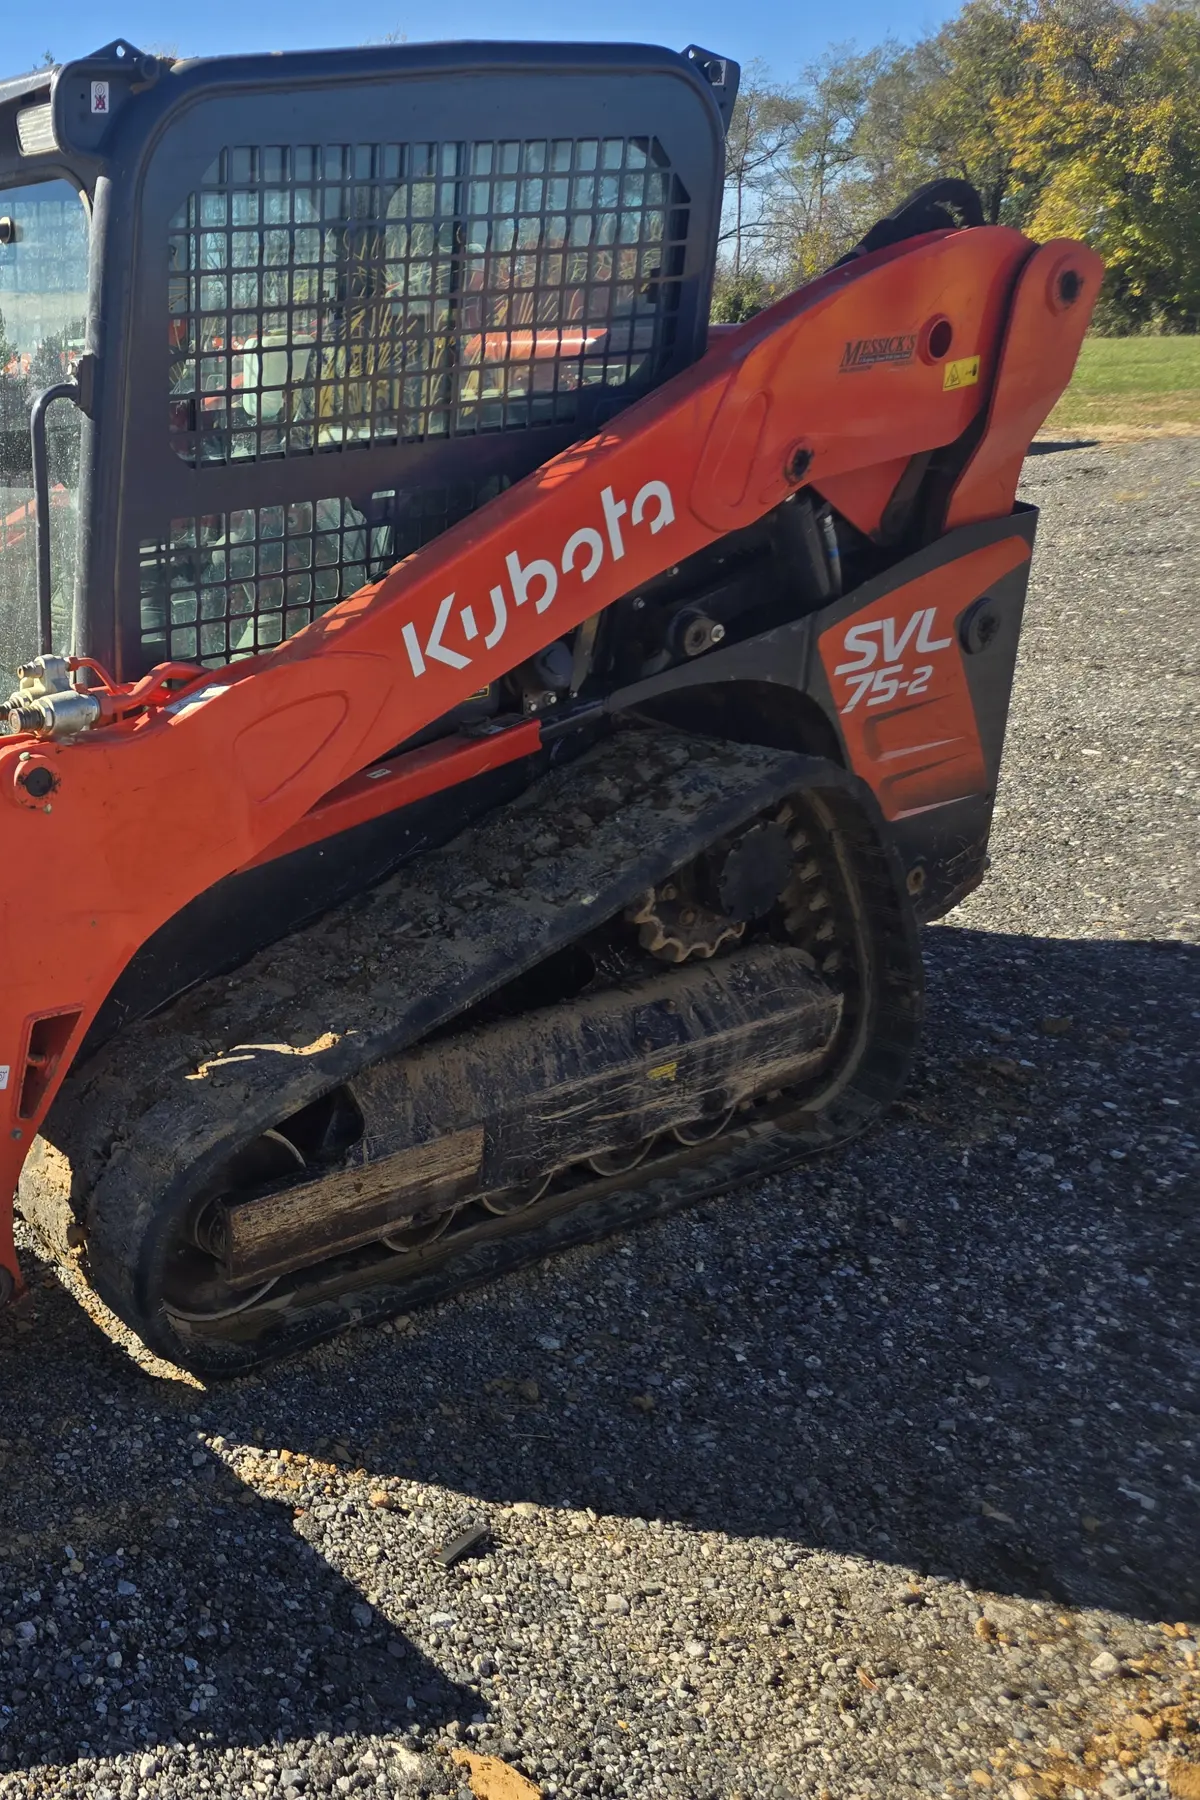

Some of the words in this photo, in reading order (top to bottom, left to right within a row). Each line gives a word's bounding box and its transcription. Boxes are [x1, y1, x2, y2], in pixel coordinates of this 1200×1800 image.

[839, 334, 917, 368] MESSICK'S
[401, 480, 676, 678] Kubota
[834, 607, 952, 676] SVL
[840, 664, 934, 715] 75-2
